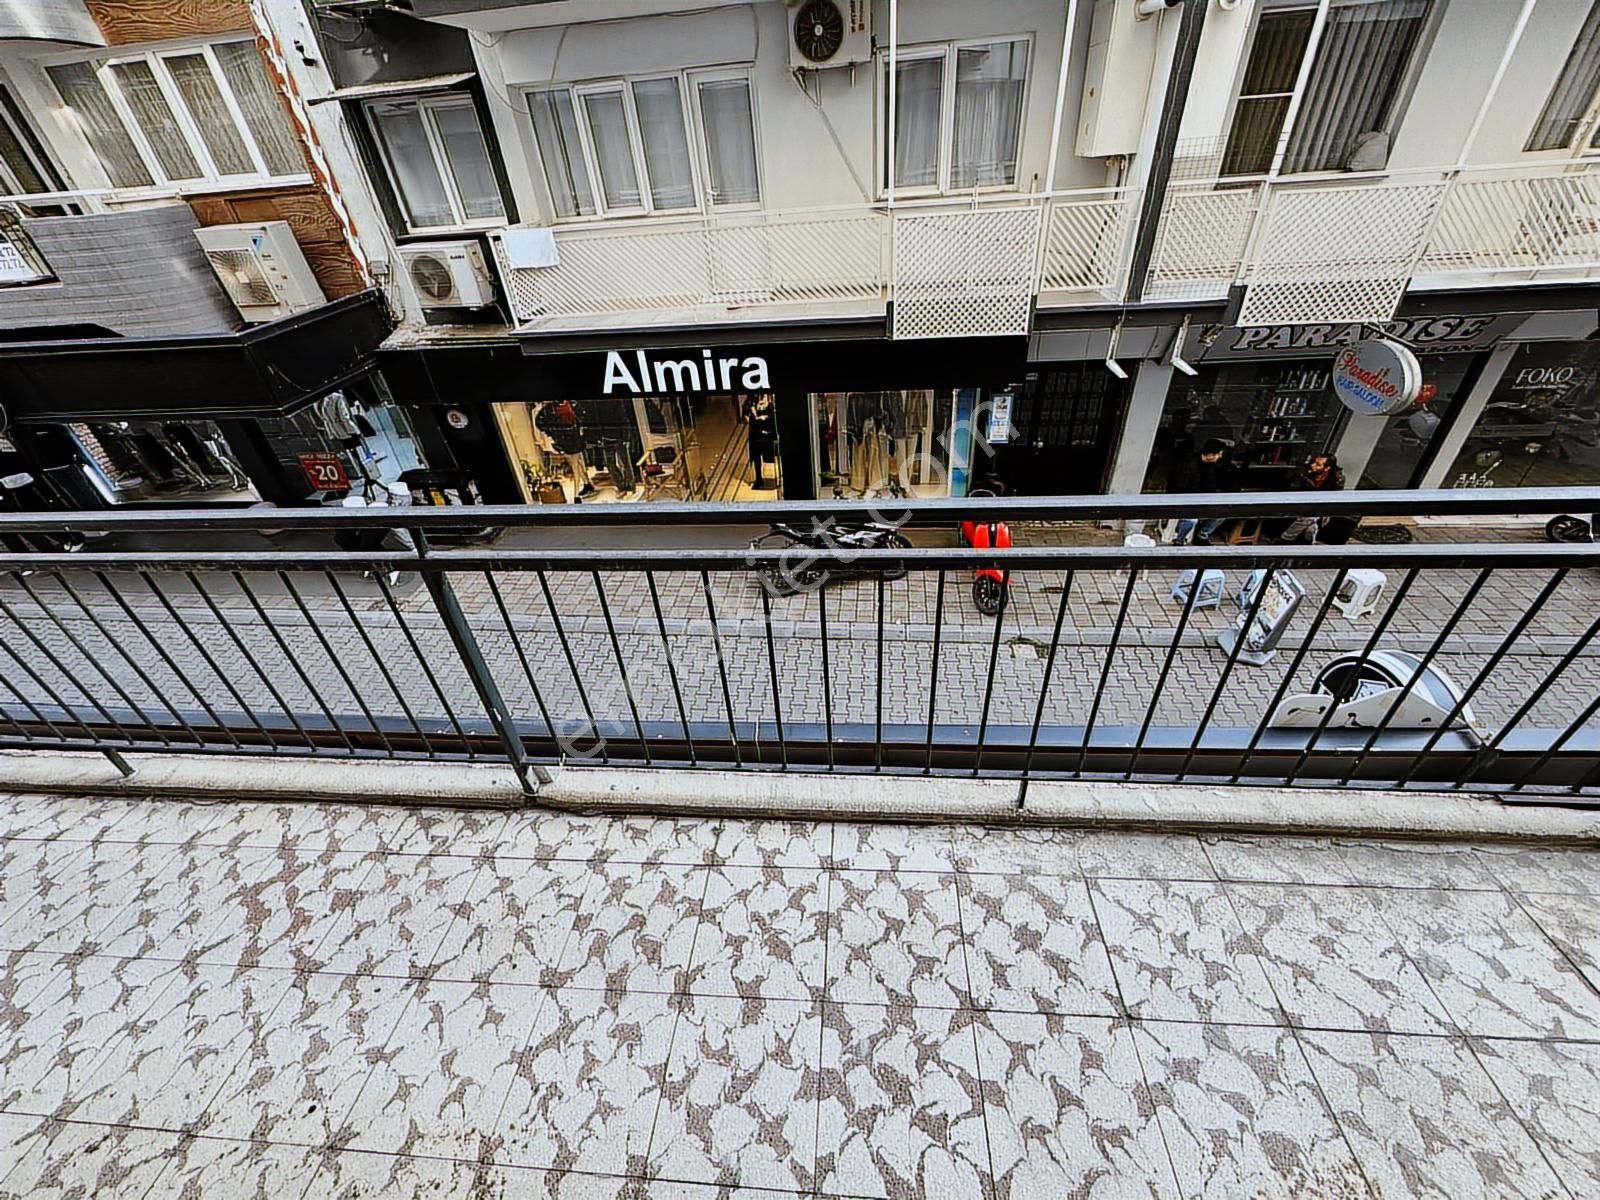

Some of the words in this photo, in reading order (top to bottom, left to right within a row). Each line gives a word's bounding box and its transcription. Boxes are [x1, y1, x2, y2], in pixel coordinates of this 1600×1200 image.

[1232, 316, 1496, 350] PARADISE
[603, 349, 771, 394] Almira
[1339, 350, 1399, 397] Paradise
[1515, 367, 1574, 384] FOKO
